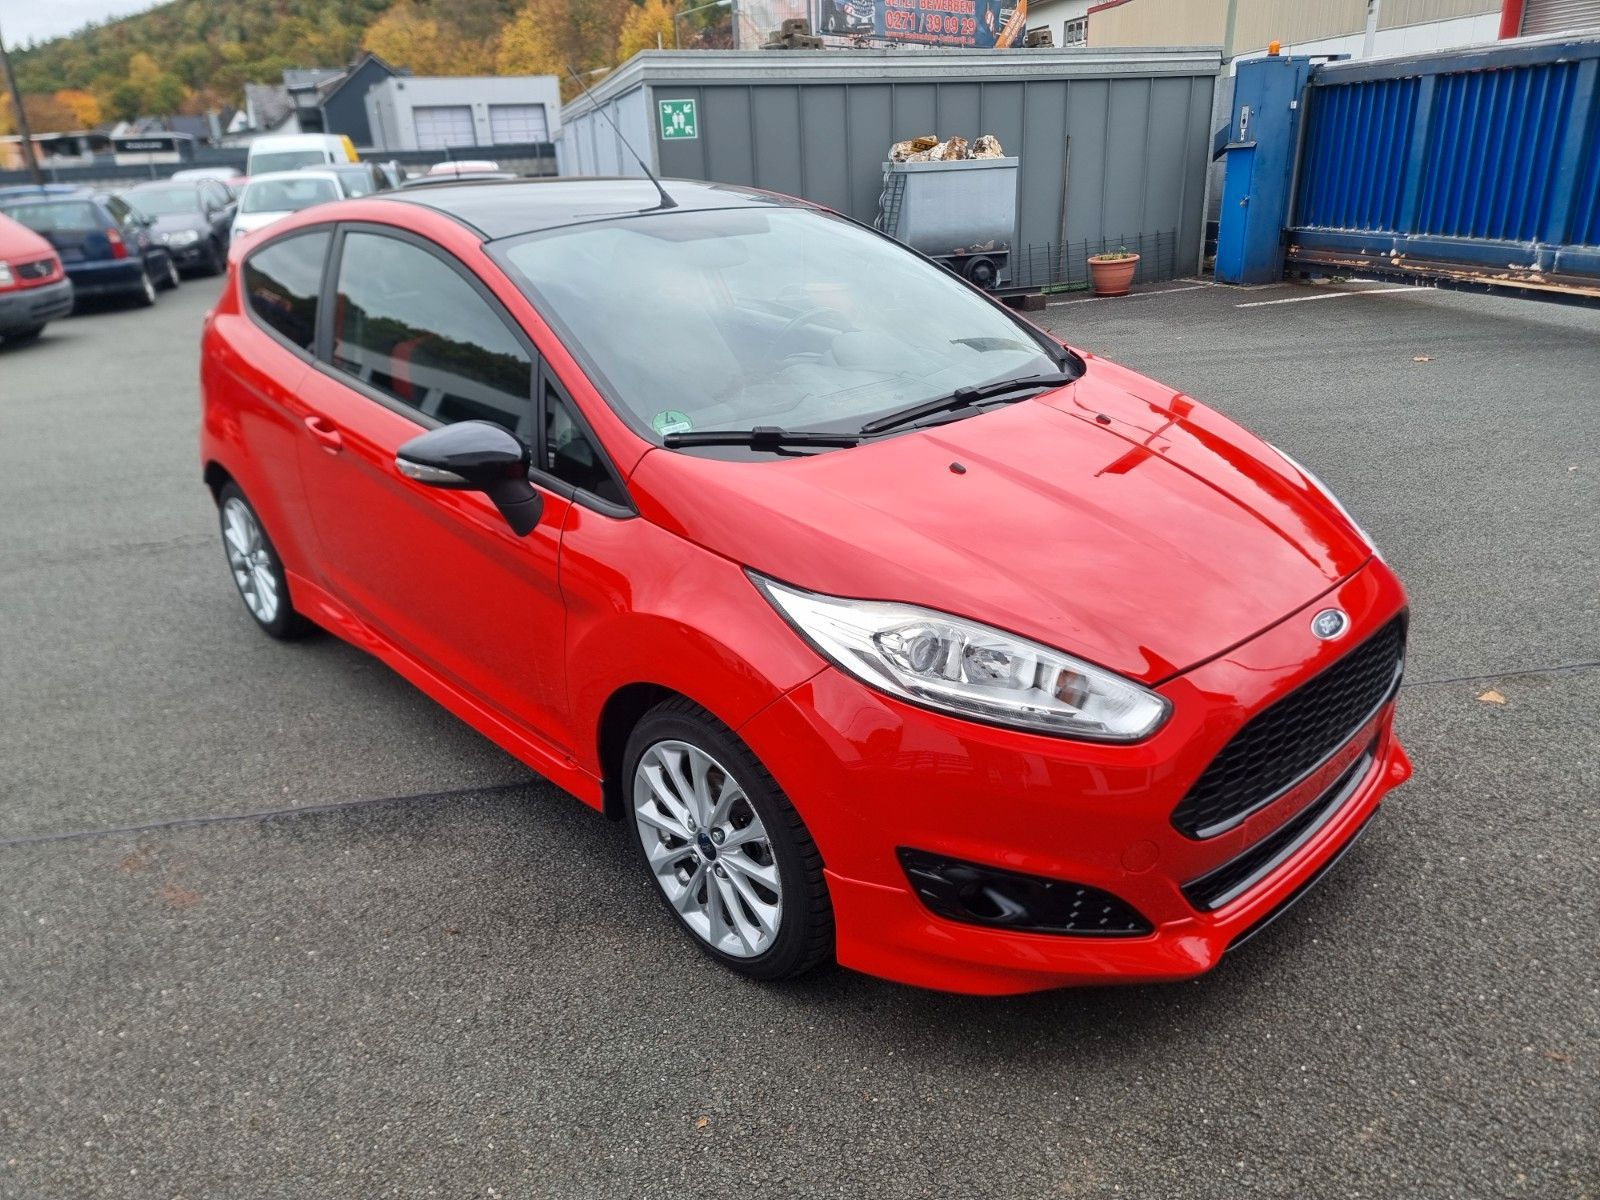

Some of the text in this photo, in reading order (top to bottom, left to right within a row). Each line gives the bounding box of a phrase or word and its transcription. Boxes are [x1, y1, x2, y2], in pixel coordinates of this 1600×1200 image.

[919, 0, 976, 14] BEWERBEN!
[885, 9, 916, 31] 0271
[918, 13, 925, 33] /
[926, 13, 942, 32] 39
[943, 15, 959, 34] 09
[961, 17, 976, 35] 29
